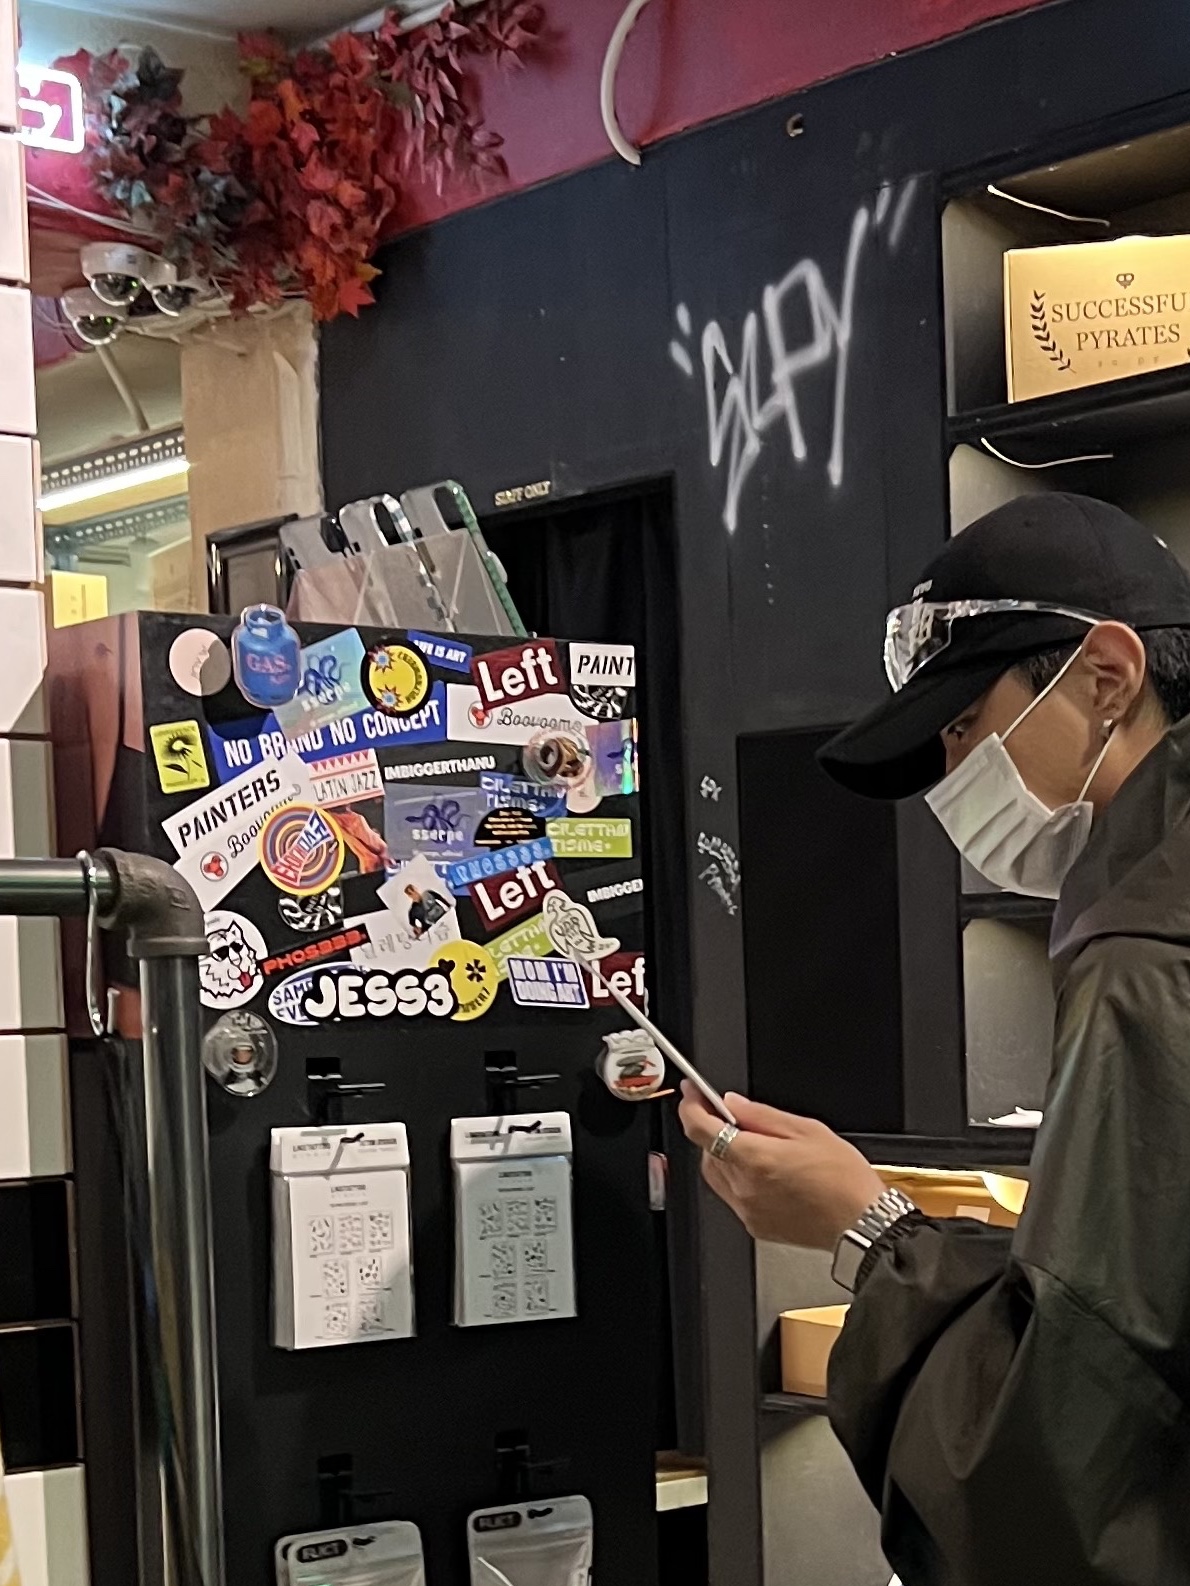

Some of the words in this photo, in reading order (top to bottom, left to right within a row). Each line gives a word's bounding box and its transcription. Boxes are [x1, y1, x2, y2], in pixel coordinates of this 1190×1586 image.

[1076, 323, 1181, 351] PYRATES
[477, 647, 558, 703] Left
[223, 739, 251, 769] NO
[258, 727, 324, 761] BRAND
[330, 719, 357, 746] NO
[363, 700, 440, 739] CONCEPT
[177, 769, 281, 848] PAINTERS
[312, 776, 348, 801] LATIN
[350, 770, 379, 796] JAZZ
[474, 861, 556, 922] Left
[304, 973, 454, 1018] JESS3
